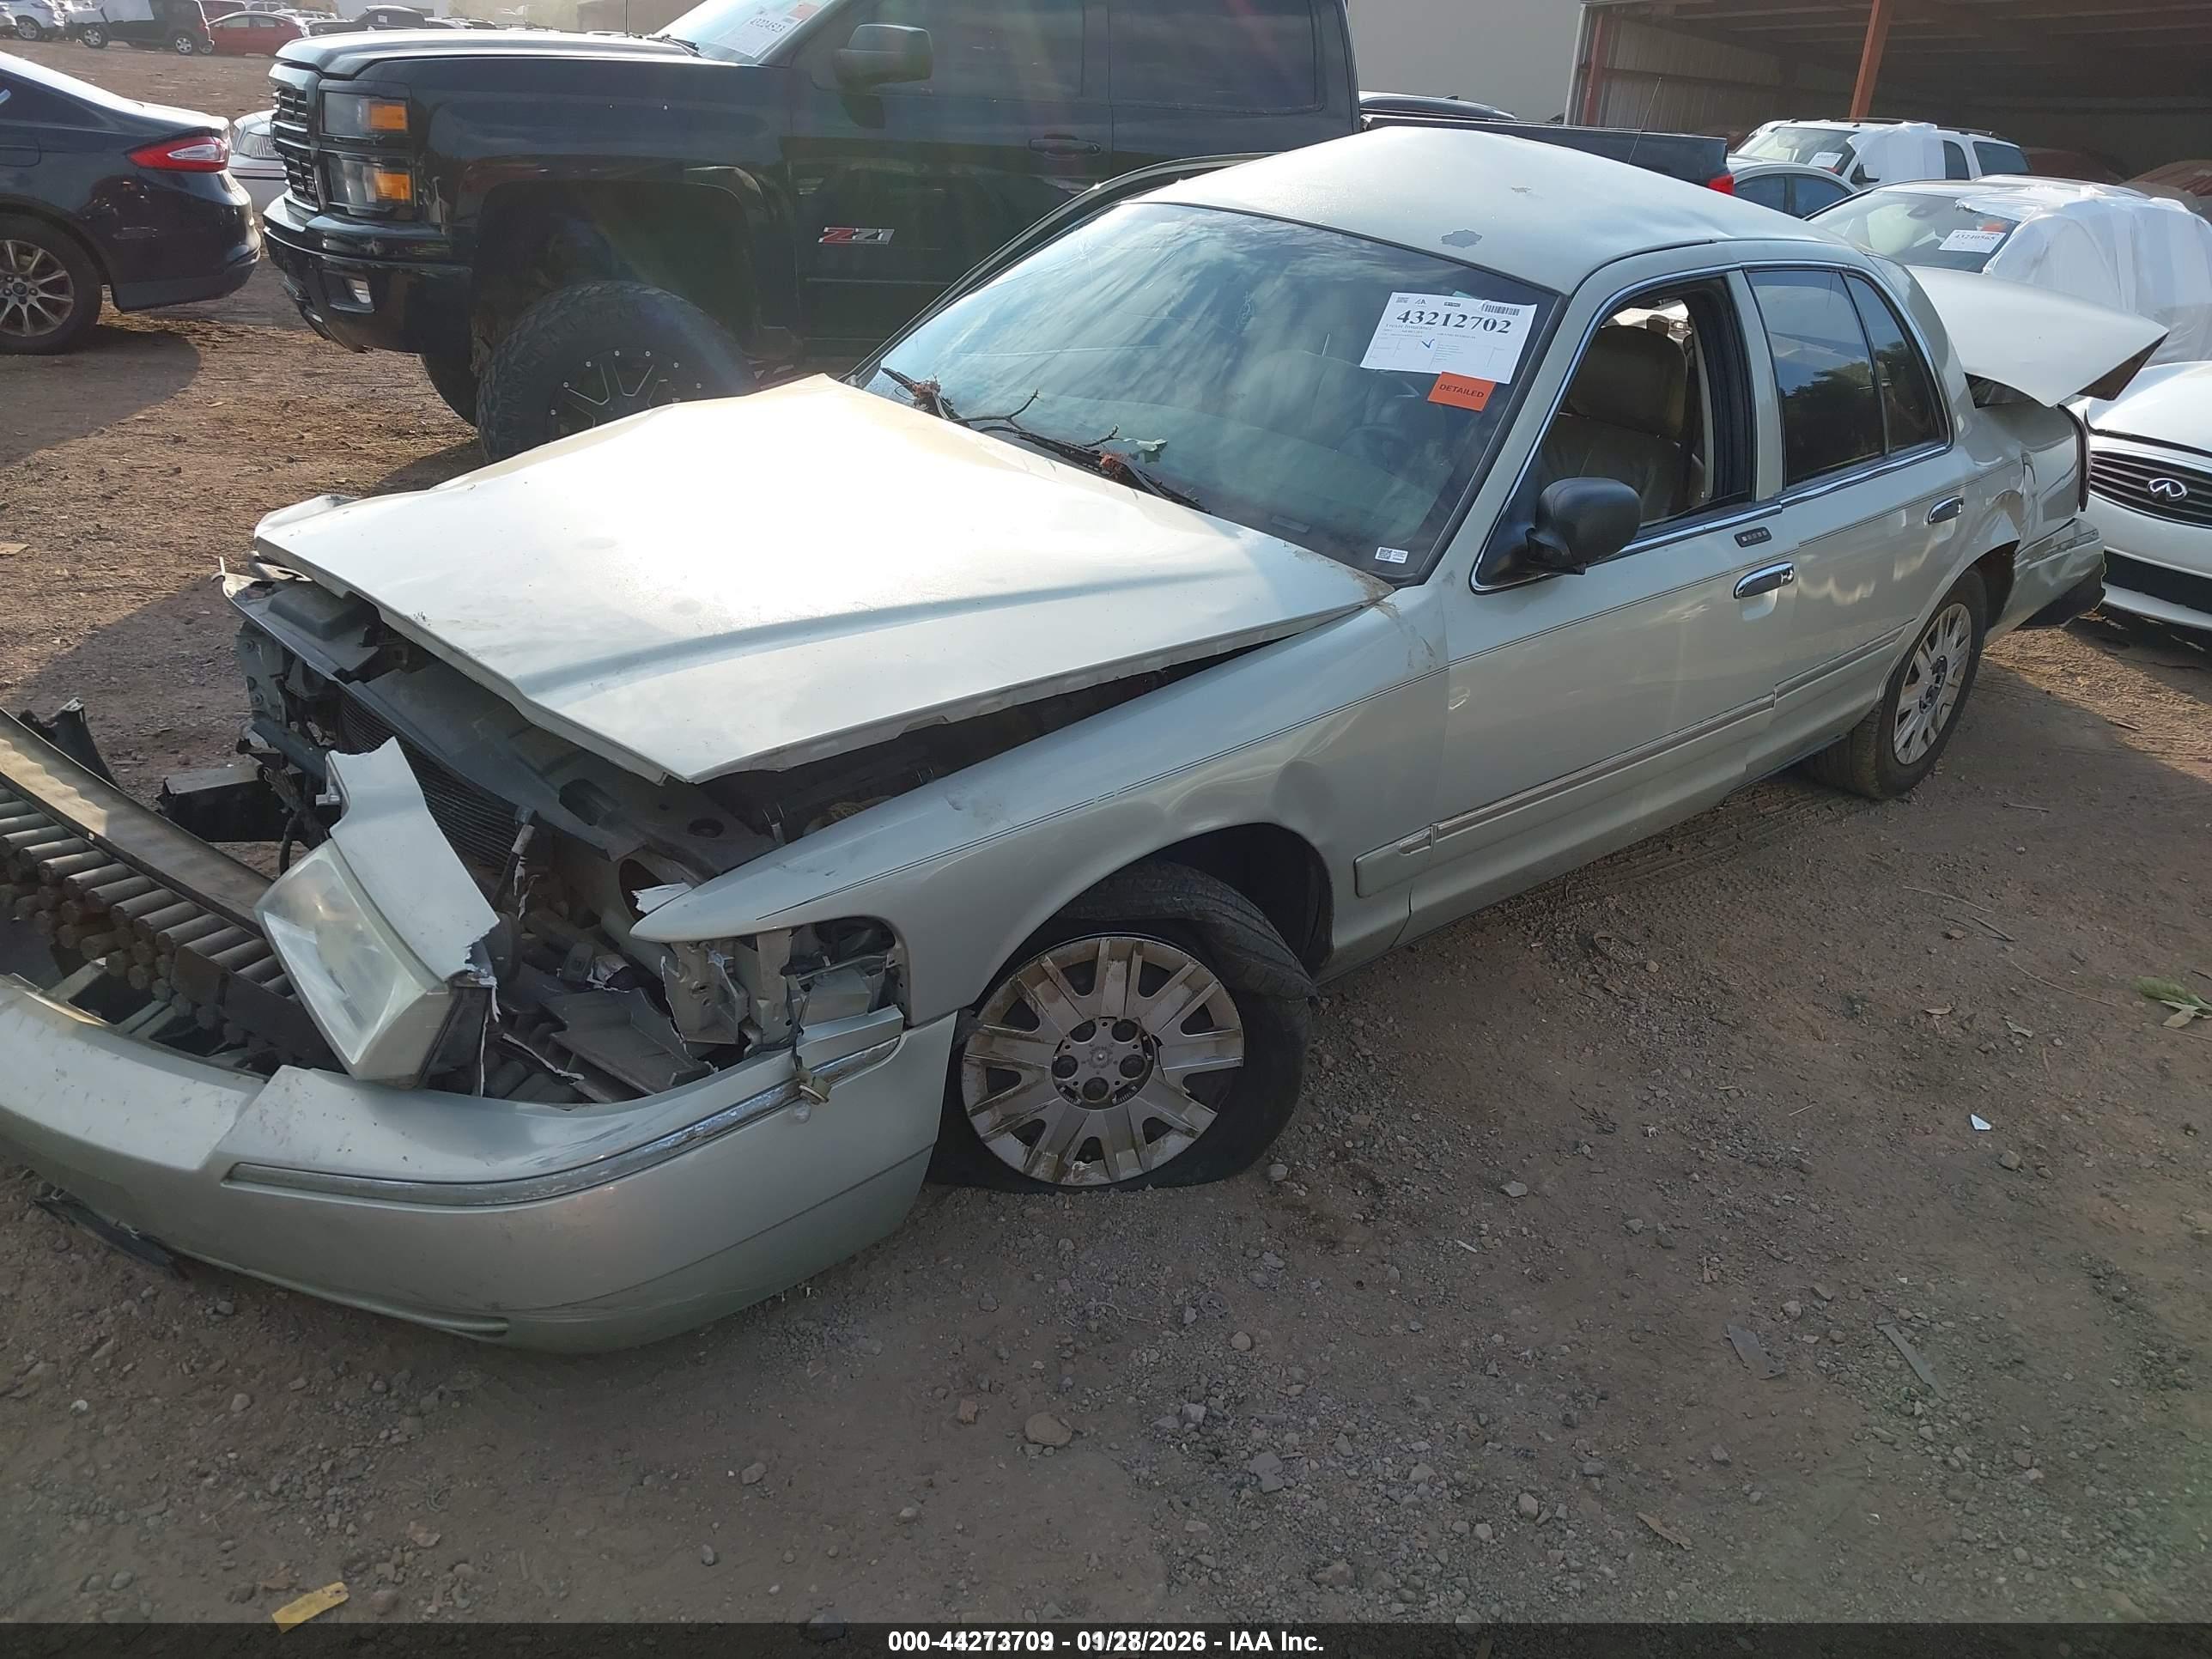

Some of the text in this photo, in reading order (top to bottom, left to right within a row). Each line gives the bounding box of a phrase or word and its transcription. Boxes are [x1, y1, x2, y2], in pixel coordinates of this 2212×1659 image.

[818, 227, 895, 245] Z71
[1396, 309, 1512, 334] 43212702
[1439, 384, 1485, 398] DETAILED
